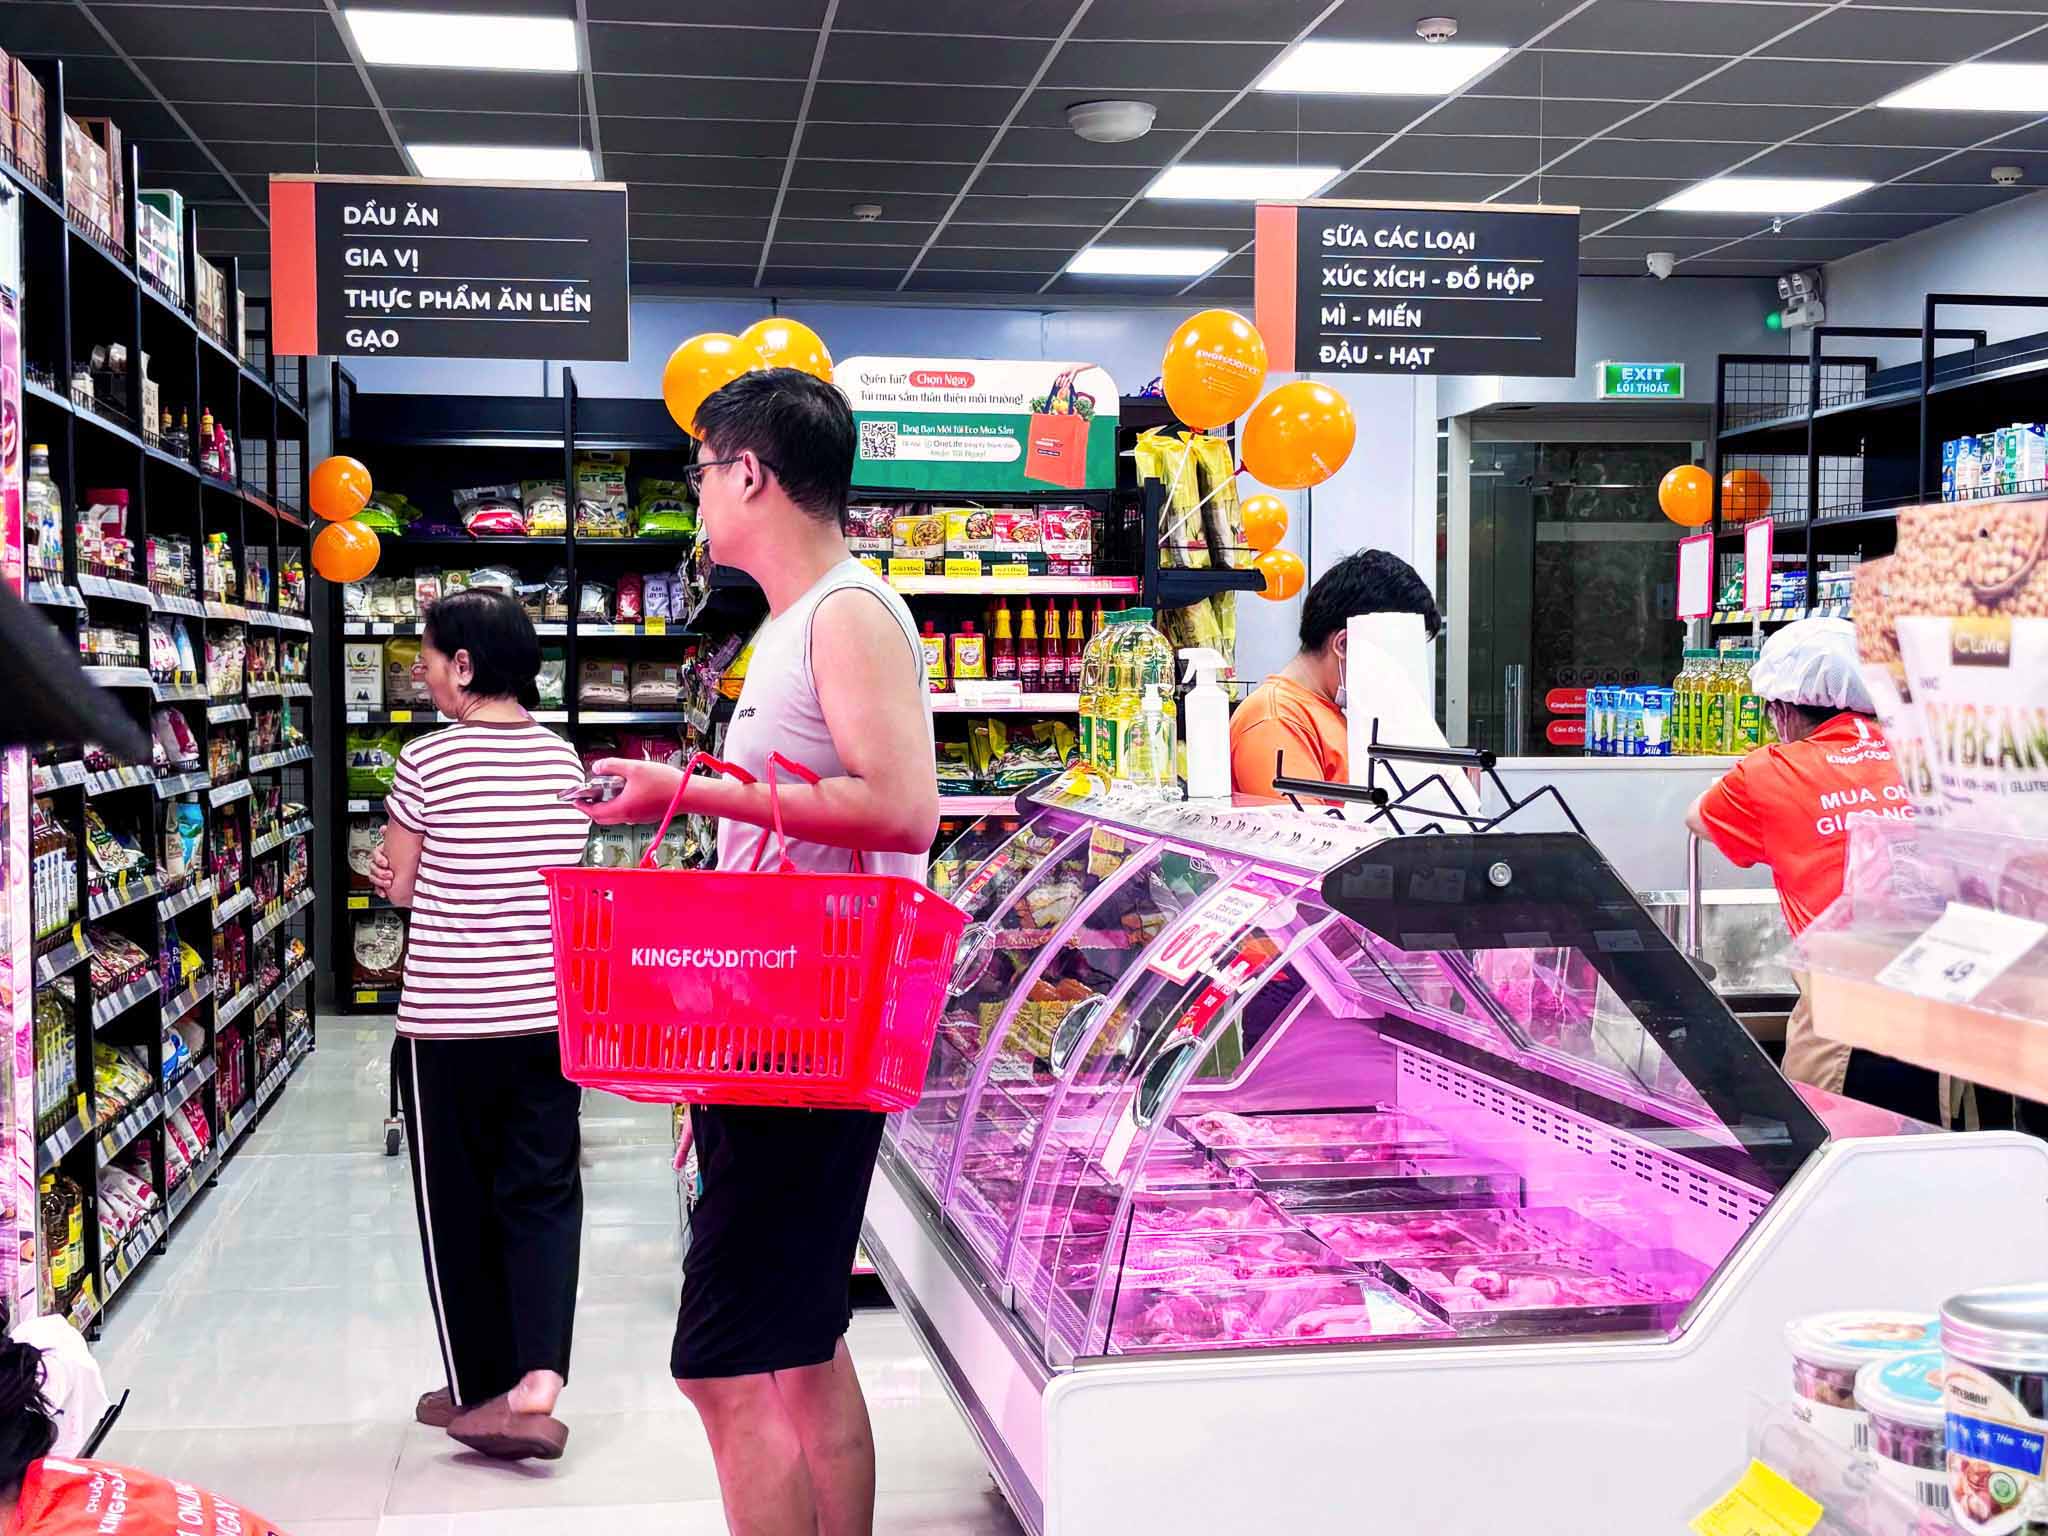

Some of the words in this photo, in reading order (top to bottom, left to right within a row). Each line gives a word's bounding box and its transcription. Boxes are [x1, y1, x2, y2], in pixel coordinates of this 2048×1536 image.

[344, 199, 396, 226] DẦU
[403, 202, 439, 227] ĂN
[1322, 225, 1368, 248] SỮA
[1374, 224, 1419, 250] CÁC
[1425, 231, 1475, 255] LOẠI
[345, 248, 388, 268] GIA
[394, 249, 419, 273] VỊ
[1322, 264, 1367, 288] XÚC
[1373, 265, 1425, 289] XÍCH
[1486, 266, 1535, 295] HỘP
[344, 288, 412, 313] THỰC
[419, 284, 491, 311] PHẨM
[497, 287, 533, 312] ĂN
[539, 285, 591, 313] LIỀN
[1321, 302, 1346, 326] MÌ
[1368, 302, 1421, 328] MIẾN
[345, 329, 399, 353] GẠO
[1319, 340, 1368, 369] ĐẬU
[1389, 347, 1435, 370] HẠT
[917, 373, 943, 388] Chọn
[944, 373, 969, 388] Ngay
[1622, 367, 1665, 380] EXIT
[1637, 382, 1669, 393] THOÁT
[1820, 788, 1877, 811] MUA
[631, 945, 798, 969] KINGFOODmart
